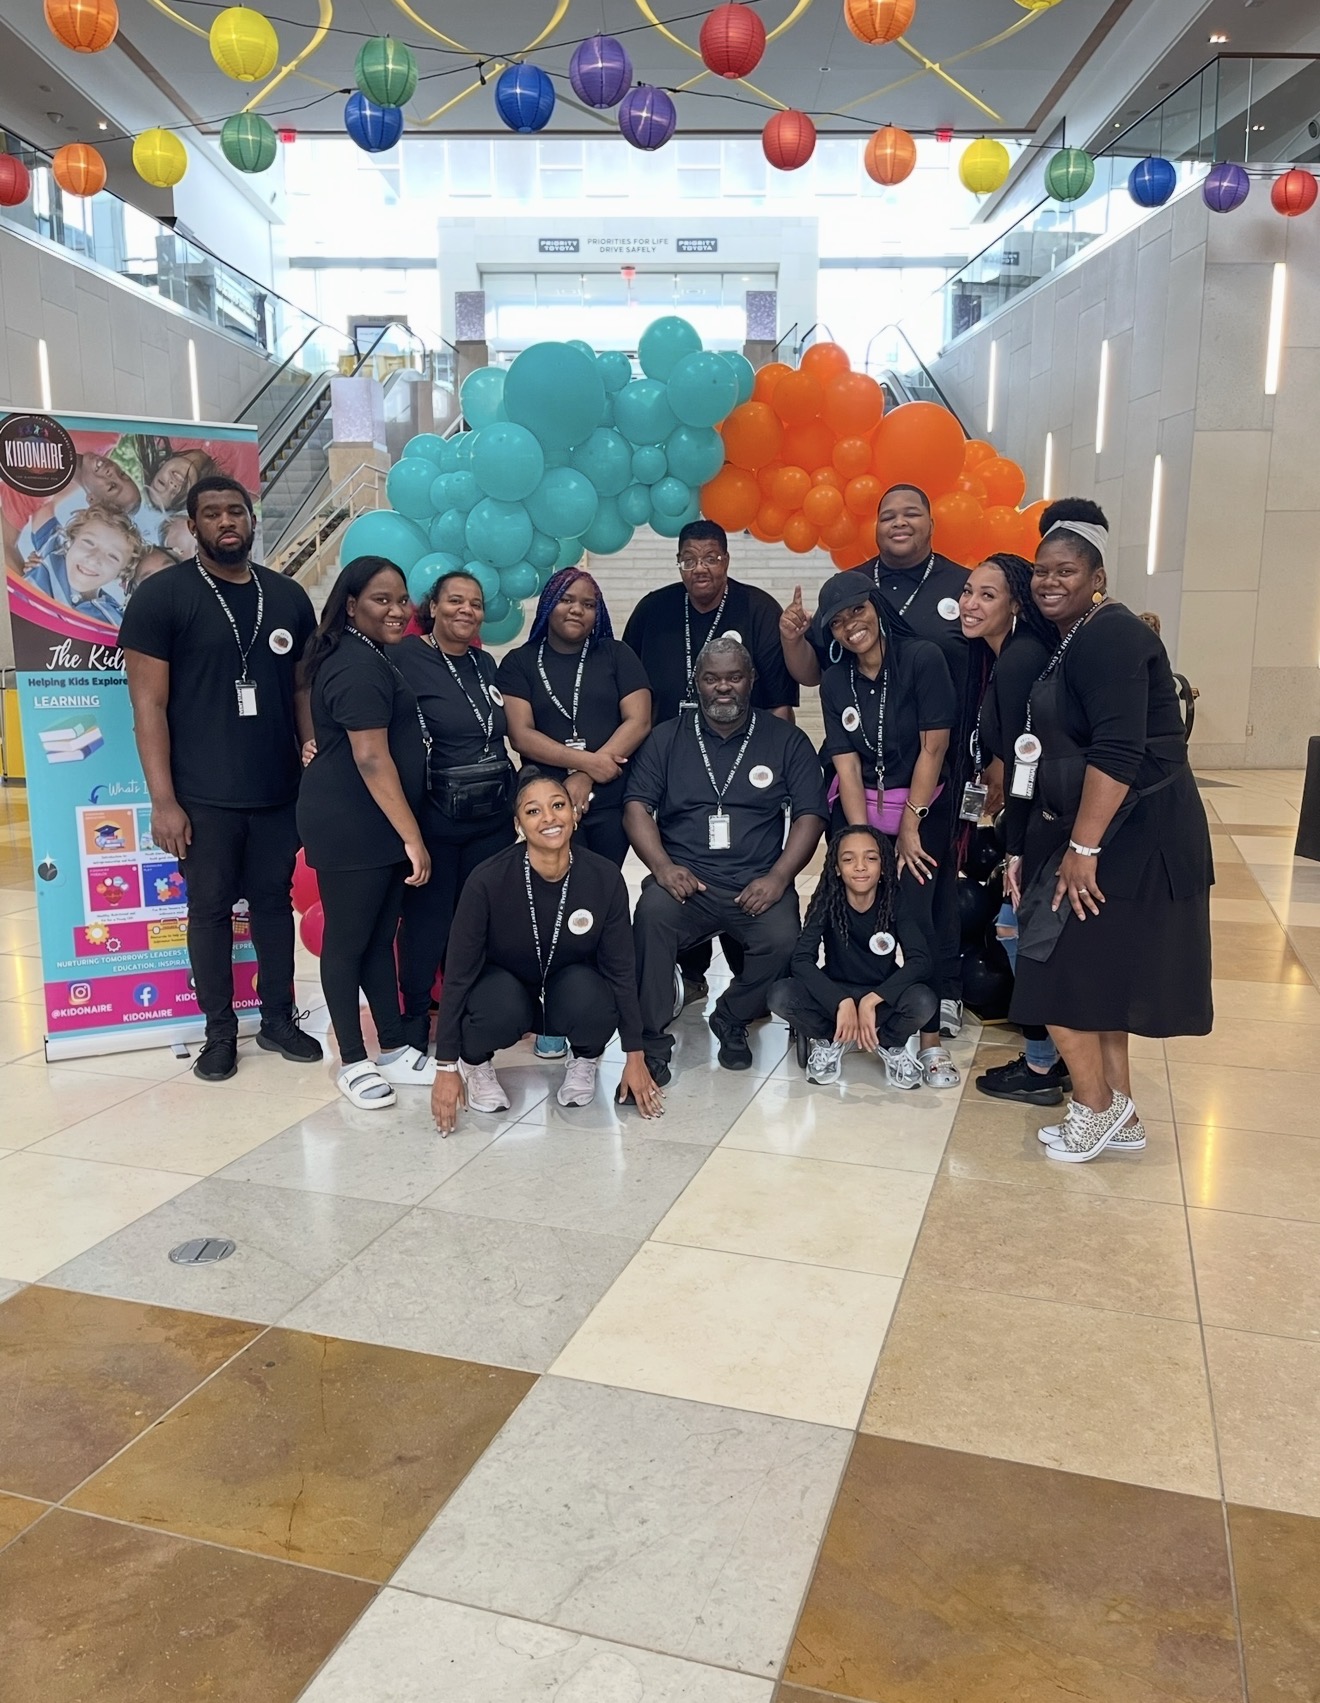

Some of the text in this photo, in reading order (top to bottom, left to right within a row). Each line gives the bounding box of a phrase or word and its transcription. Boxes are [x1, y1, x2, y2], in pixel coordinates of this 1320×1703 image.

[4, 440, 65, 470] KIDONAIRE
[713, 599, 726, 625] EVENT STAFF
[1060, 633, 1073, 650] STAFF
[45, 638, 82, 670] The
[28, 676, 128, 688] Helping Kids Explore
[34, 695, 100, 708] LEARNING
[702, 753, 711, 767] EVENT
[735, 739, 749, 766] EVENT STAFF
[525, 883, 533, 900] STAFF
[560, 887, 568, 904] EVENT
[552, 909, 563, 944] EVENT STAFF
[56, 957, 100, 968] NURTURING
[101, 953, 149, 964] TOMORROWS
[150, 950, 182, 958] LEADERS
[112, 963, 156, 973] EDUCATION,
[51, 1003, 113, 1019] @KIDONAIRE
[122, 1008, 173, 1022] KIDONAIRE
